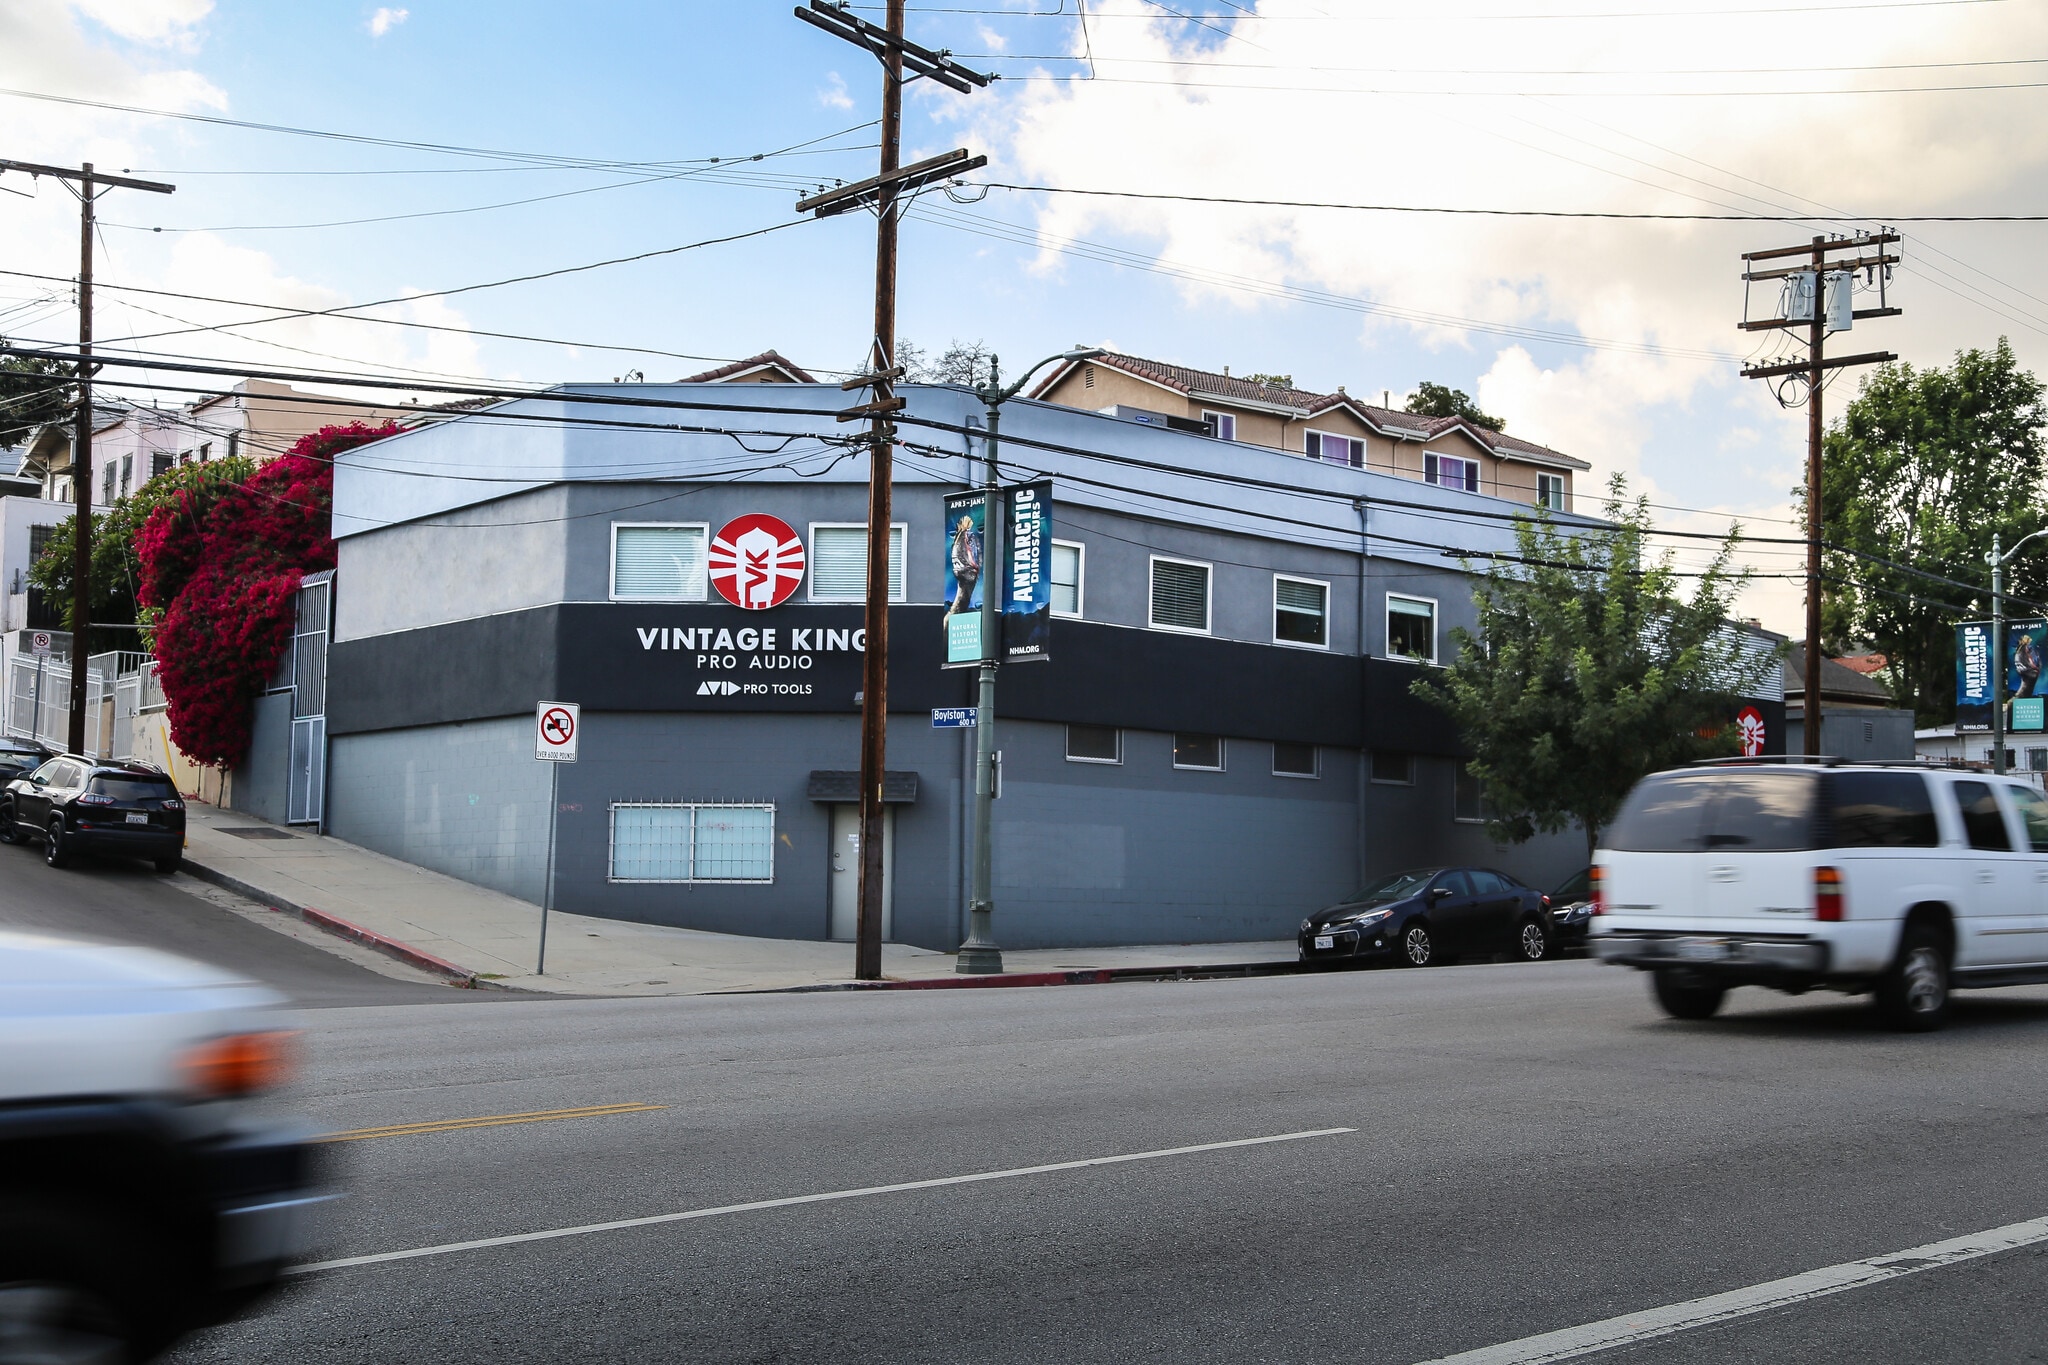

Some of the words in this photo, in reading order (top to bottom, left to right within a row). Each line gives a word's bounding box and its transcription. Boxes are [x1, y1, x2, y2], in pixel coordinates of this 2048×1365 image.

[951, 501, 962, 509] APR
[970, 499, 981, 507] JAN
[1013, 489, 1035, 602] ANTARCTIC
[1031, 501, 1041, 584] DINOSAURS
[952, 623, 977, 631] NATURAL
[636, 627, 776, 651] VINTAGE
[952, 630, 978, 638] HISTORY
[952, 637, 978, 645] MUSEUM
[1009, 645, 1039, 655] NHM.ORG
[697, 655, 737, 669] PRO
[749, 655, 813, 669] AUDIO
[1965, 627, 1982, 698] ANTARCTIC
[1979, 635, 1987, 687] DINOSAURS
[743, 684, 768, 695] PRO
[772, 684, 813, 695] TOOLS
[934, 710, 965, 722] Boylston
[548, 751, 558, 759] 6000
[560, 752, 575, 760] POUNDS
